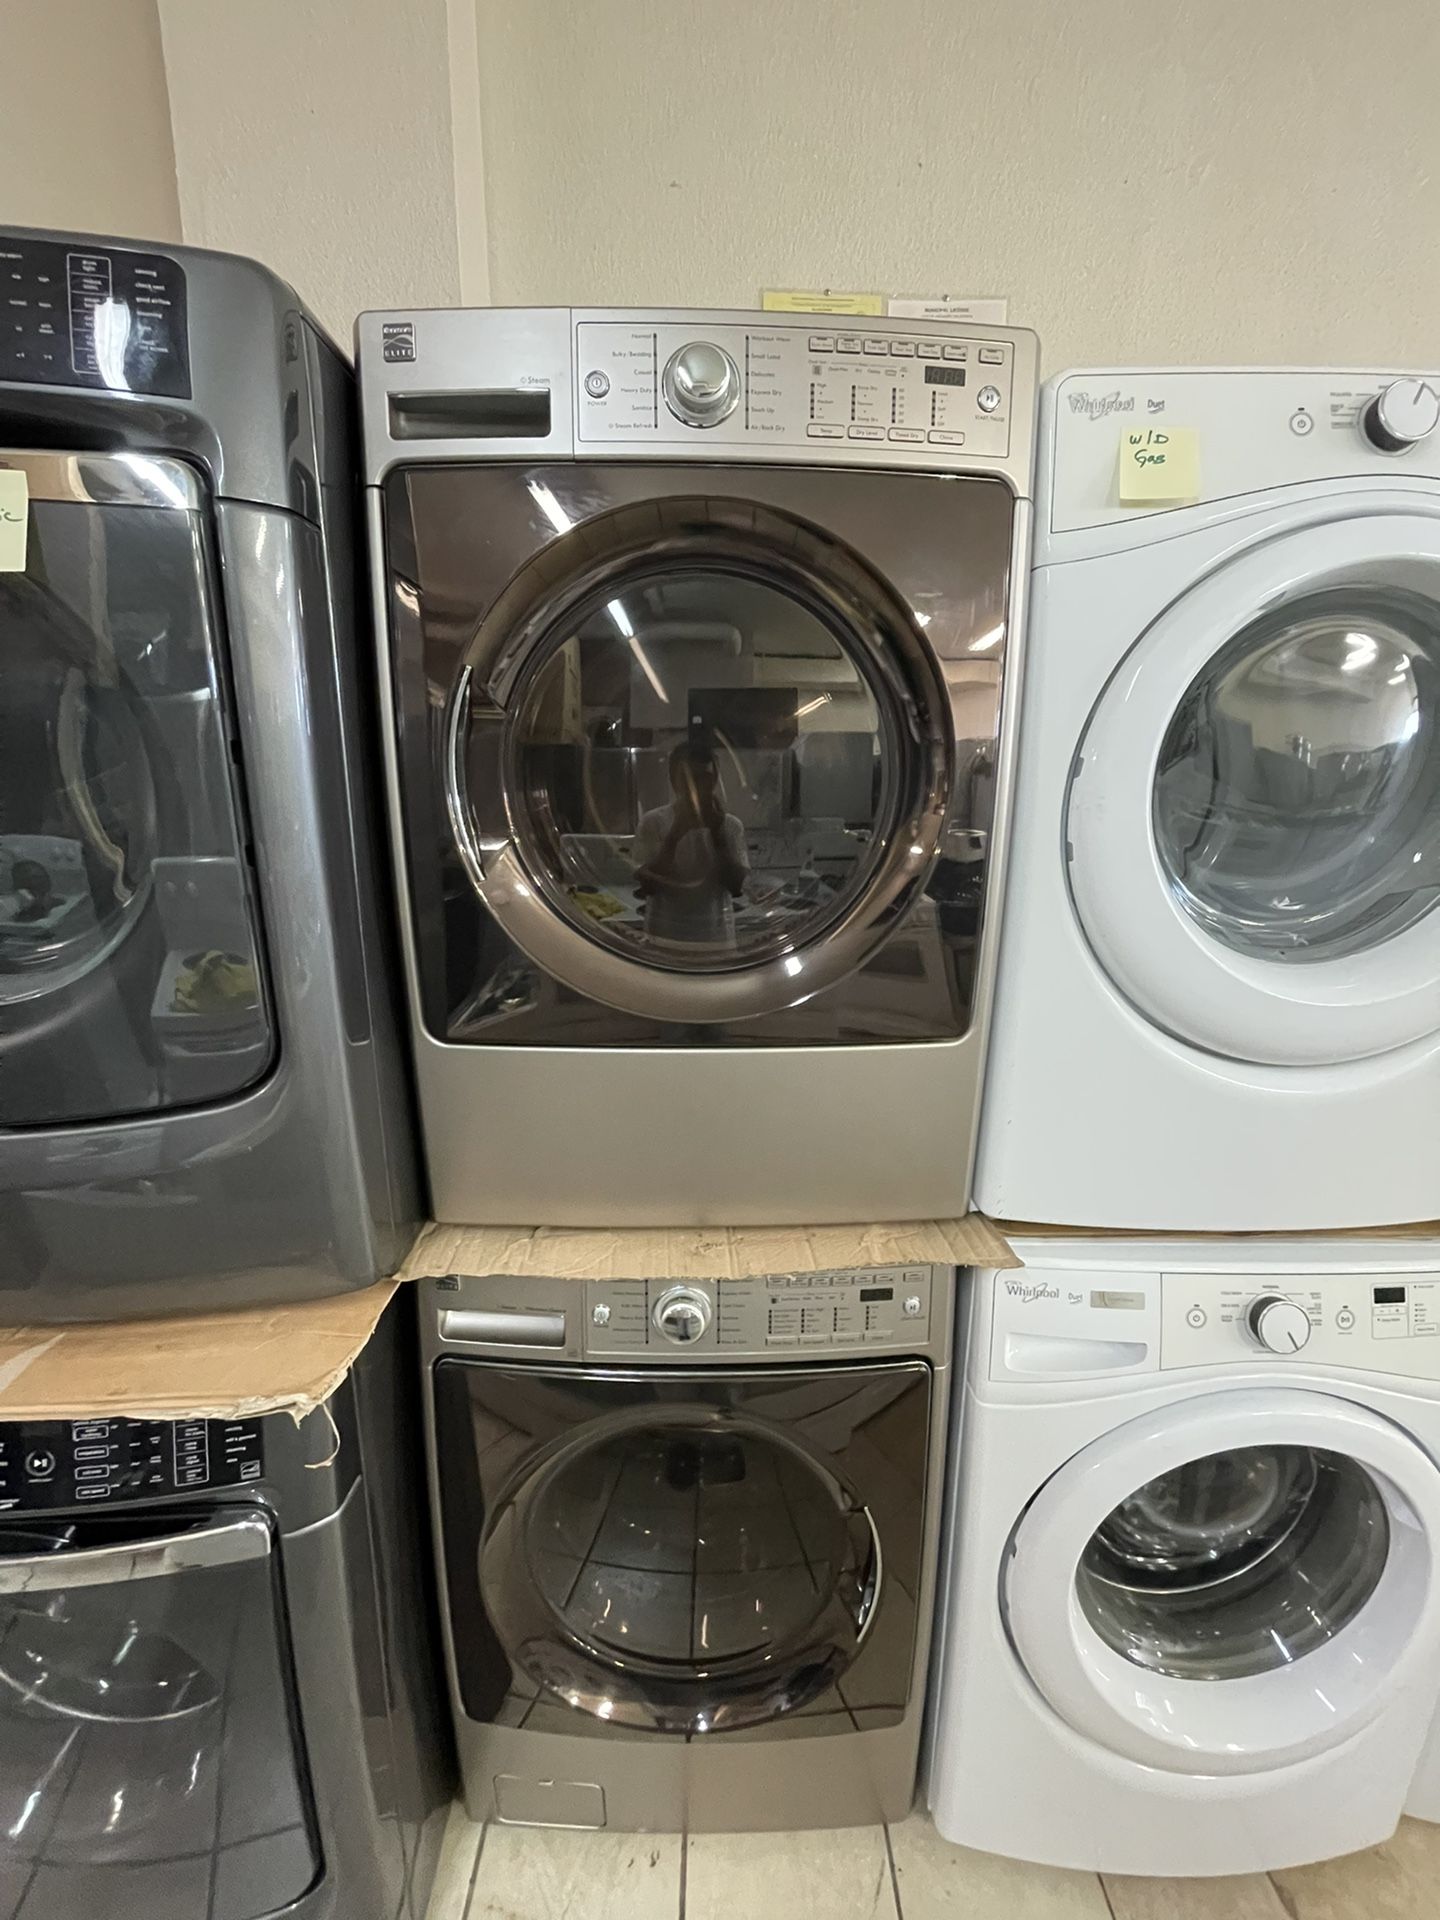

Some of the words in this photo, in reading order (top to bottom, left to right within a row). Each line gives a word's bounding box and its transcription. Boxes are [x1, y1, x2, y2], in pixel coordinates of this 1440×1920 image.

[527, 376, 551, 385] Steam
[1134, 448, 1167, 468] Gas
[1004, 1280, 1060, 1304] Whirlpool
